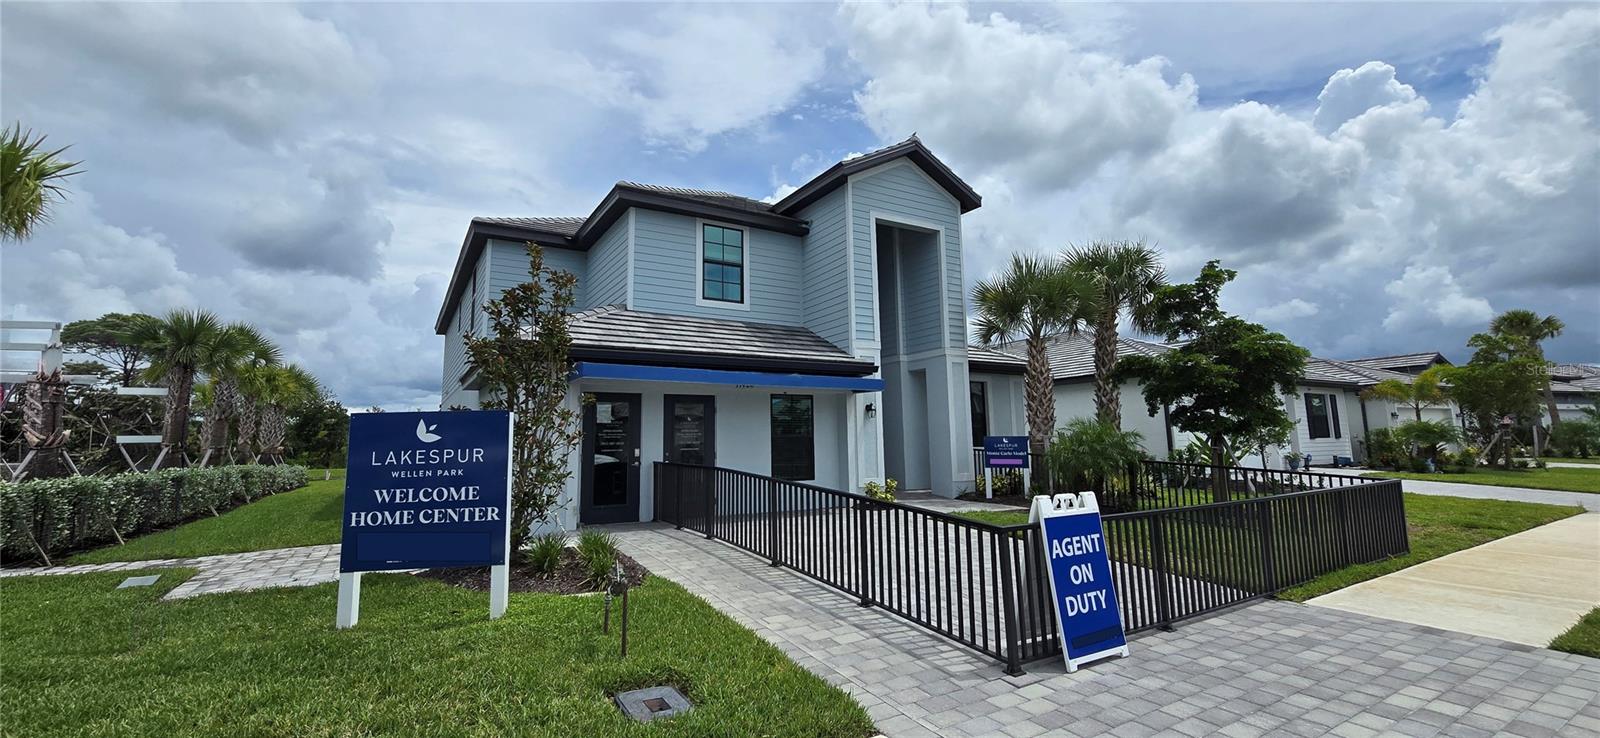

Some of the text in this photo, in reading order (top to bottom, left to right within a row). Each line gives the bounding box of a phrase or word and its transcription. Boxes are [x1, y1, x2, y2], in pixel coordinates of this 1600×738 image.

[371, 448, 484, 466] LAKESPUR
[391, 469, 464, 478] WELLEN PARK
[374, 486, 480, 503] WELCOME
[350, 506, 500, 527] HOME CENTER
[1052, 533, 1100, 559] AGENT
[1069, 563, 1094, 585] ON
[1065, 589, 1106, 617] DUTY
